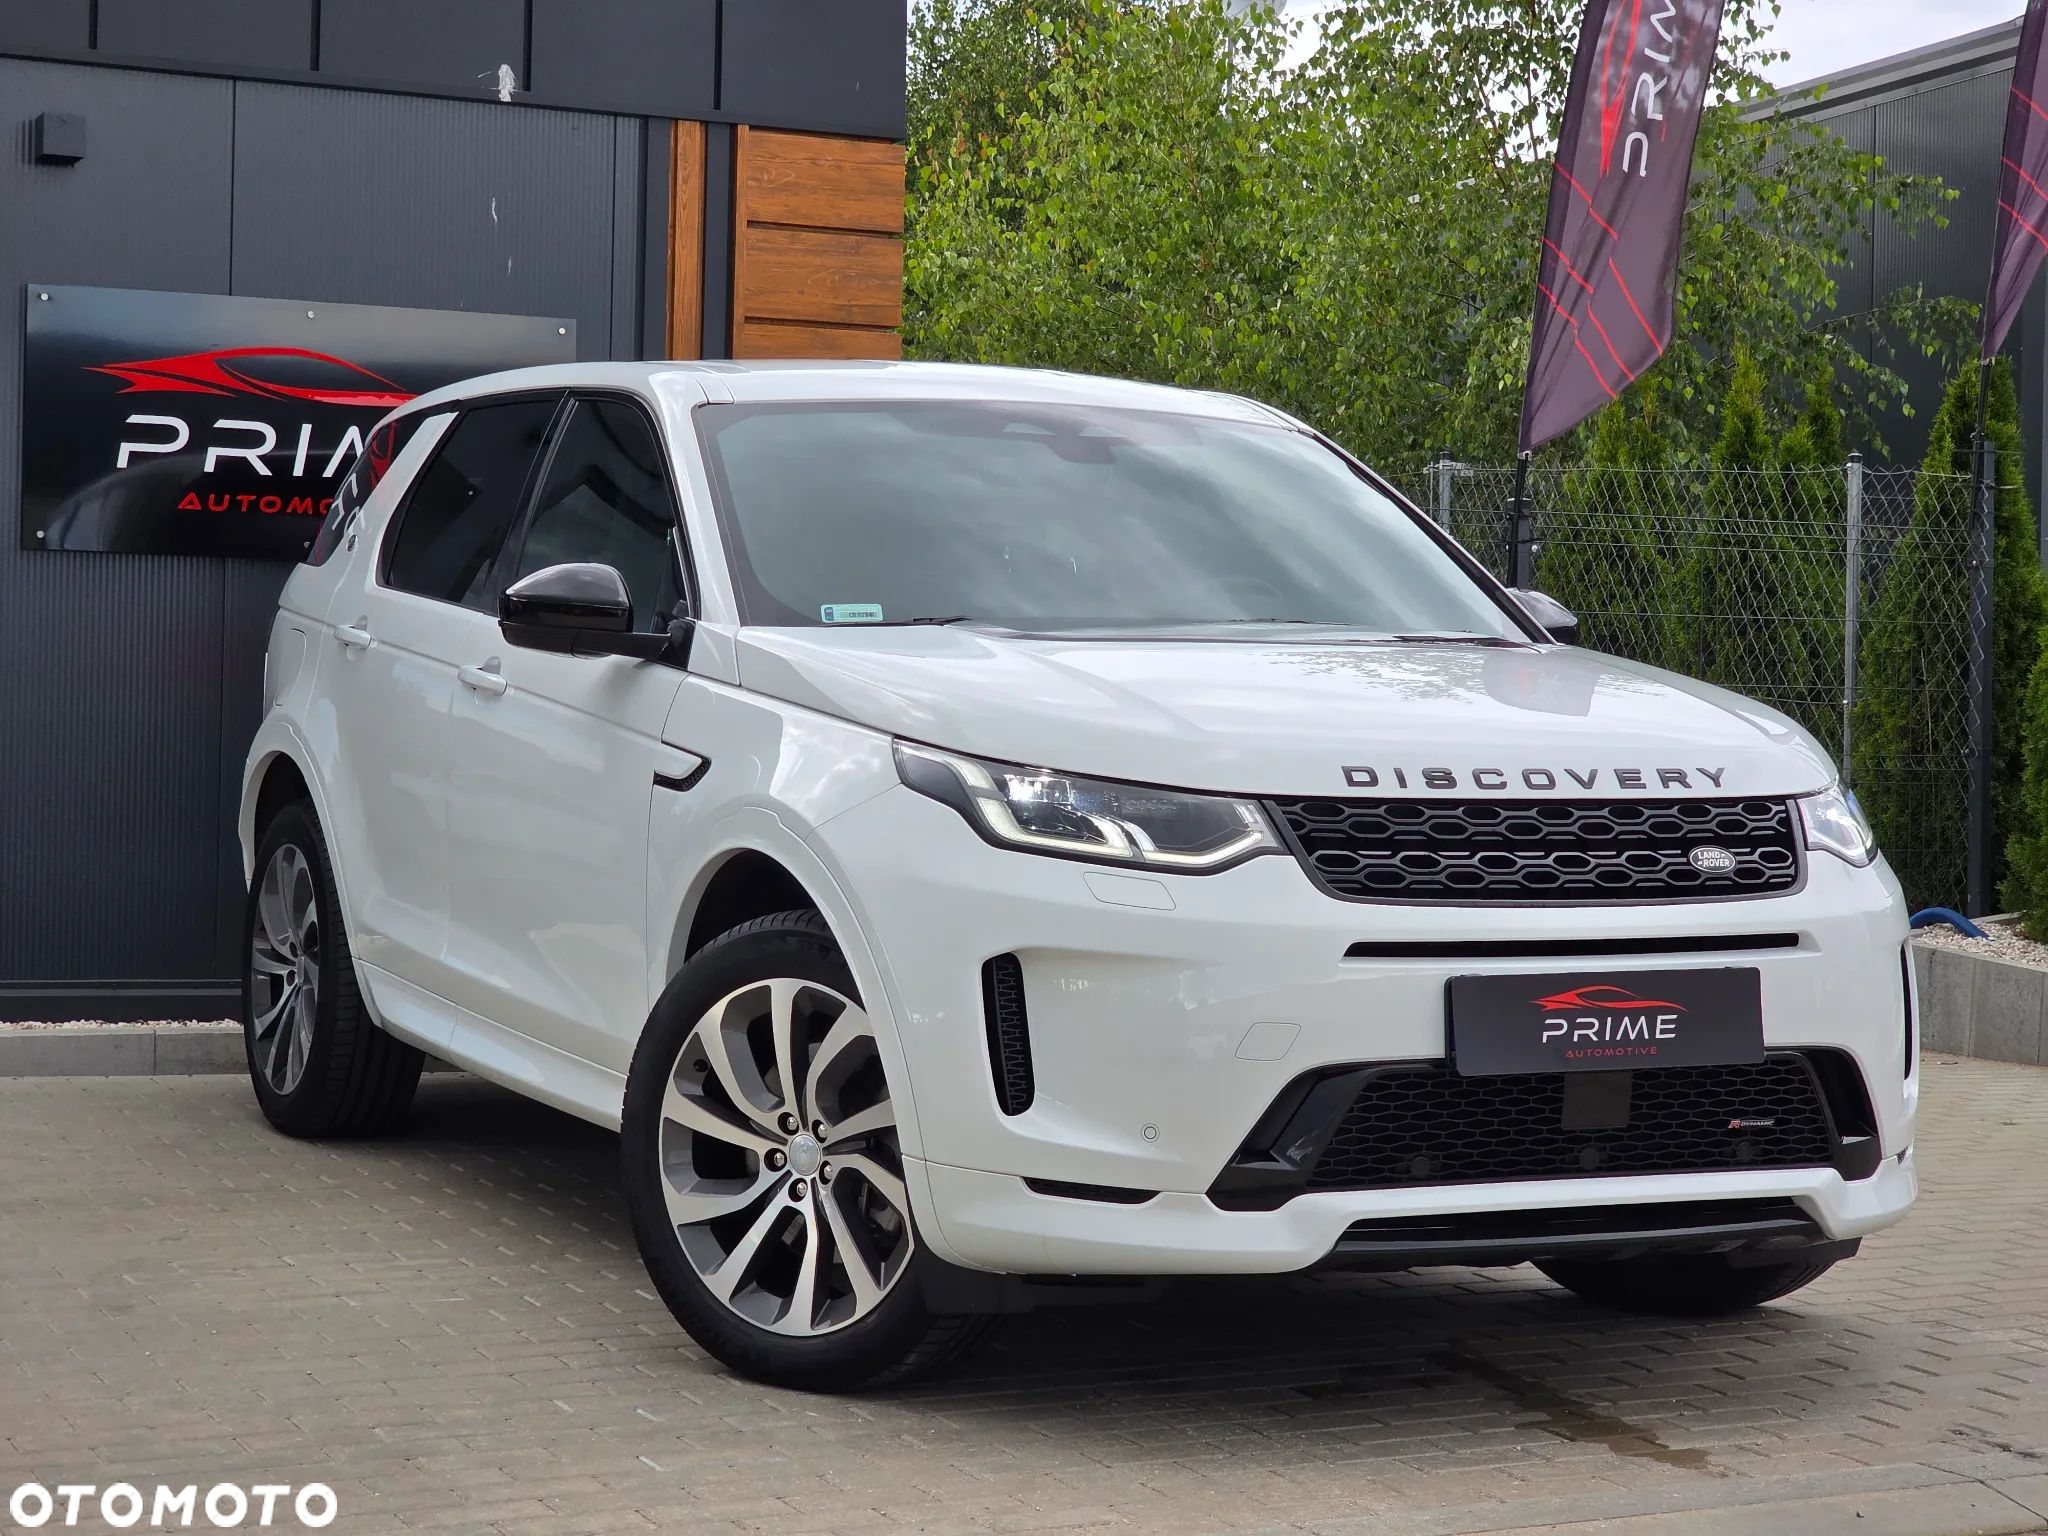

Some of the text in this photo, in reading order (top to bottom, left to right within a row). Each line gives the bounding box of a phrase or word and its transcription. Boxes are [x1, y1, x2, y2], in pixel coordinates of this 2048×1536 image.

[1341, 765, 1725, 790] DISCOVERY
[1542, 1014, 1678, 1043] PRIME
[1565, 1046, 1657, 1058] AUTOMOTIVE
